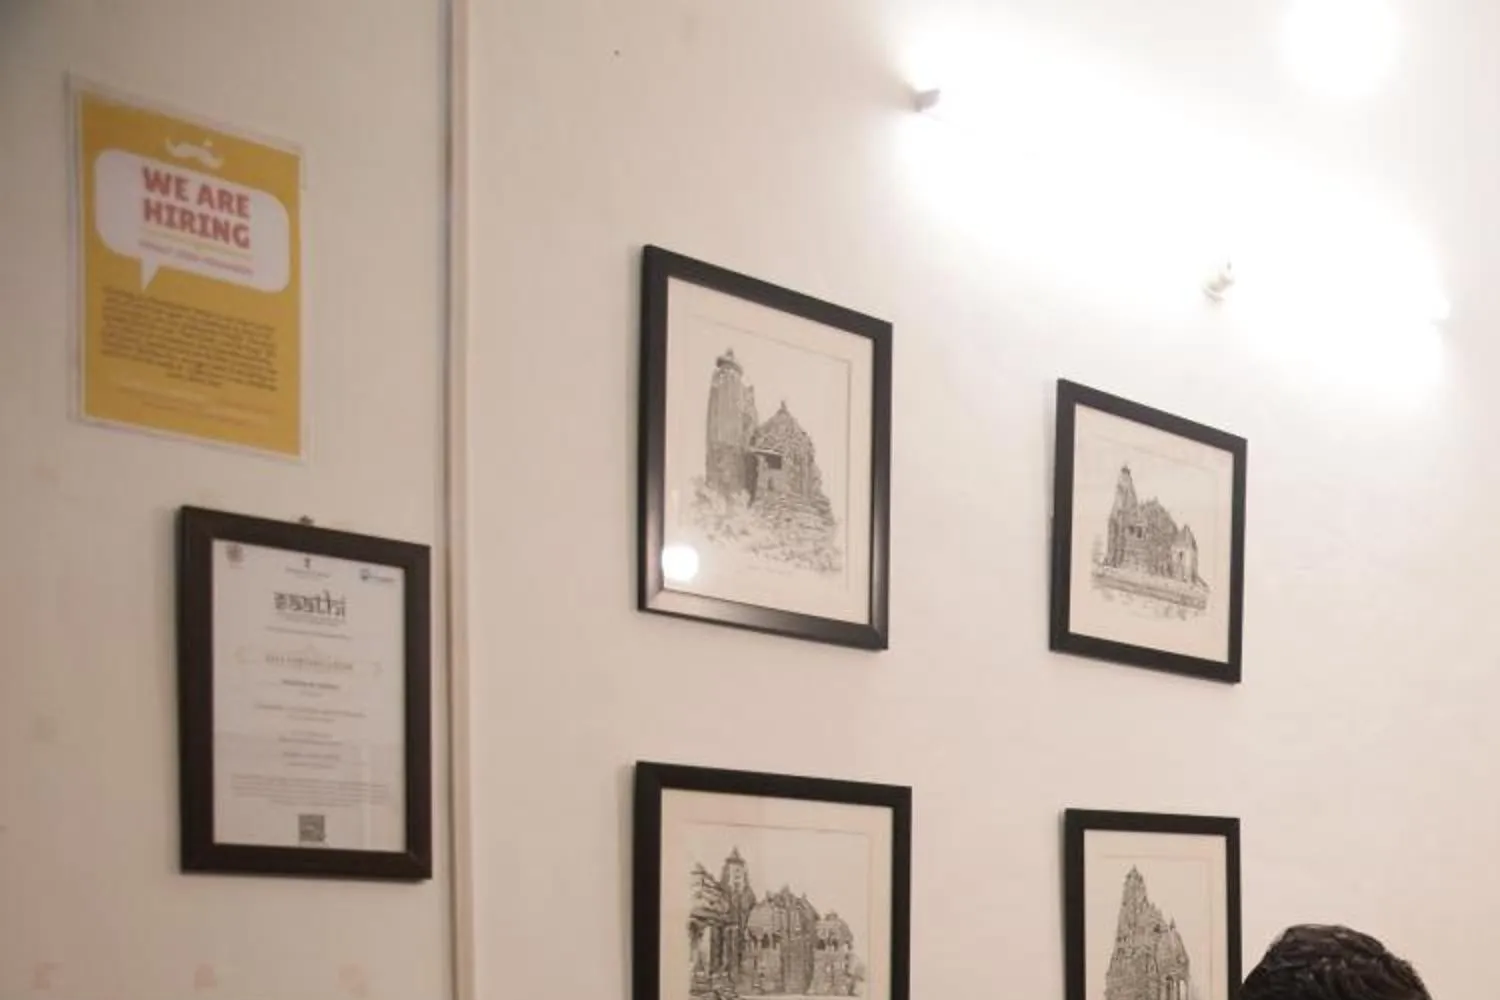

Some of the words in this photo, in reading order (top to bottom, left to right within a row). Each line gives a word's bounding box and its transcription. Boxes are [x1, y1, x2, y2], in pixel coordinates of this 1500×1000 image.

[141, 165, 189, 202] WE
[196, 183, 251, 219] ARE
[142, 197, 251, 250] HIRING
